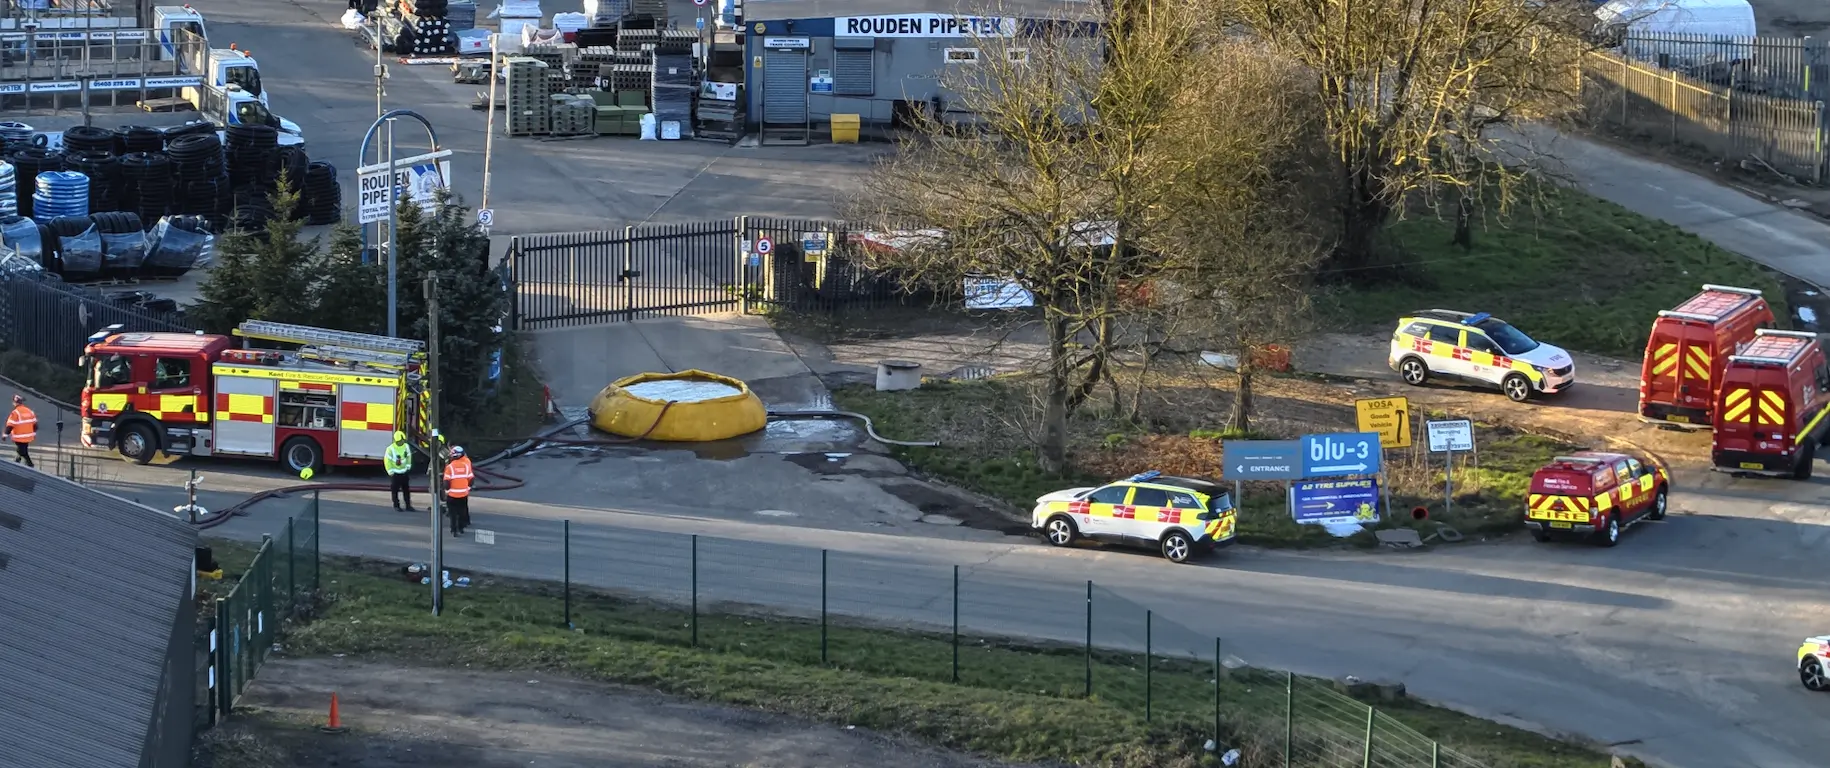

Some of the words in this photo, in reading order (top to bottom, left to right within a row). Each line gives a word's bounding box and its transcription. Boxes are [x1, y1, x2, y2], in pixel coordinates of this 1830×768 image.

[847, 18, 921, 33] ROUDEN
[929, 18, 1001, 34] PIPETEK
[481, 212, 489, 221] 5
[760, 242, 768, 251] 5
[1368, 401, 1393, 409] VOSA
[1311, 437, 1369, 461] blu-3
[1335, 480, 1372, 488] SUPPLIES
[1625, 495, 1649, 509] FIRE
[1531, 511, 1588, 521] FIRE
